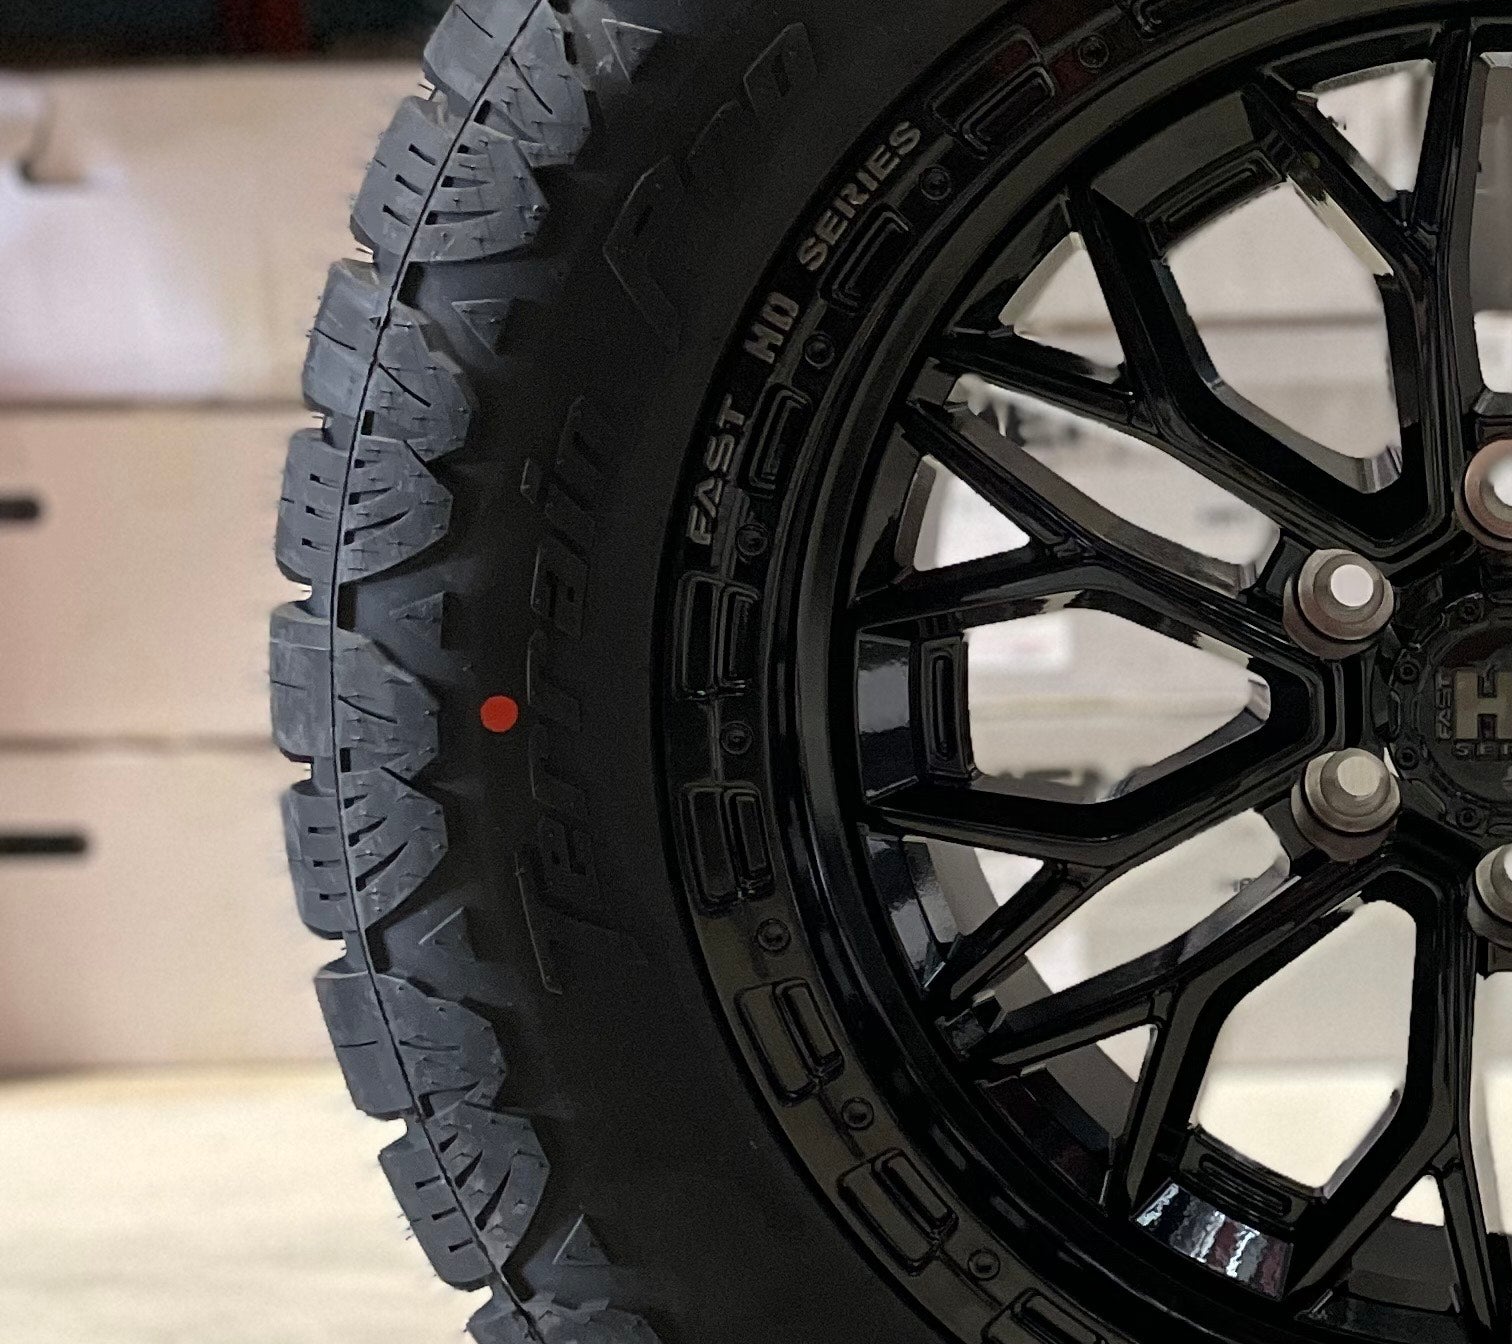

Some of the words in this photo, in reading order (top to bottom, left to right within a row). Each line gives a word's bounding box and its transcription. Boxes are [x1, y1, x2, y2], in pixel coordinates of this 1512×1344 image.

[688, 393, 746, 545] FAST
[743, 291, 799, 364] HD
[798, 120, 921, 272] SERIES
